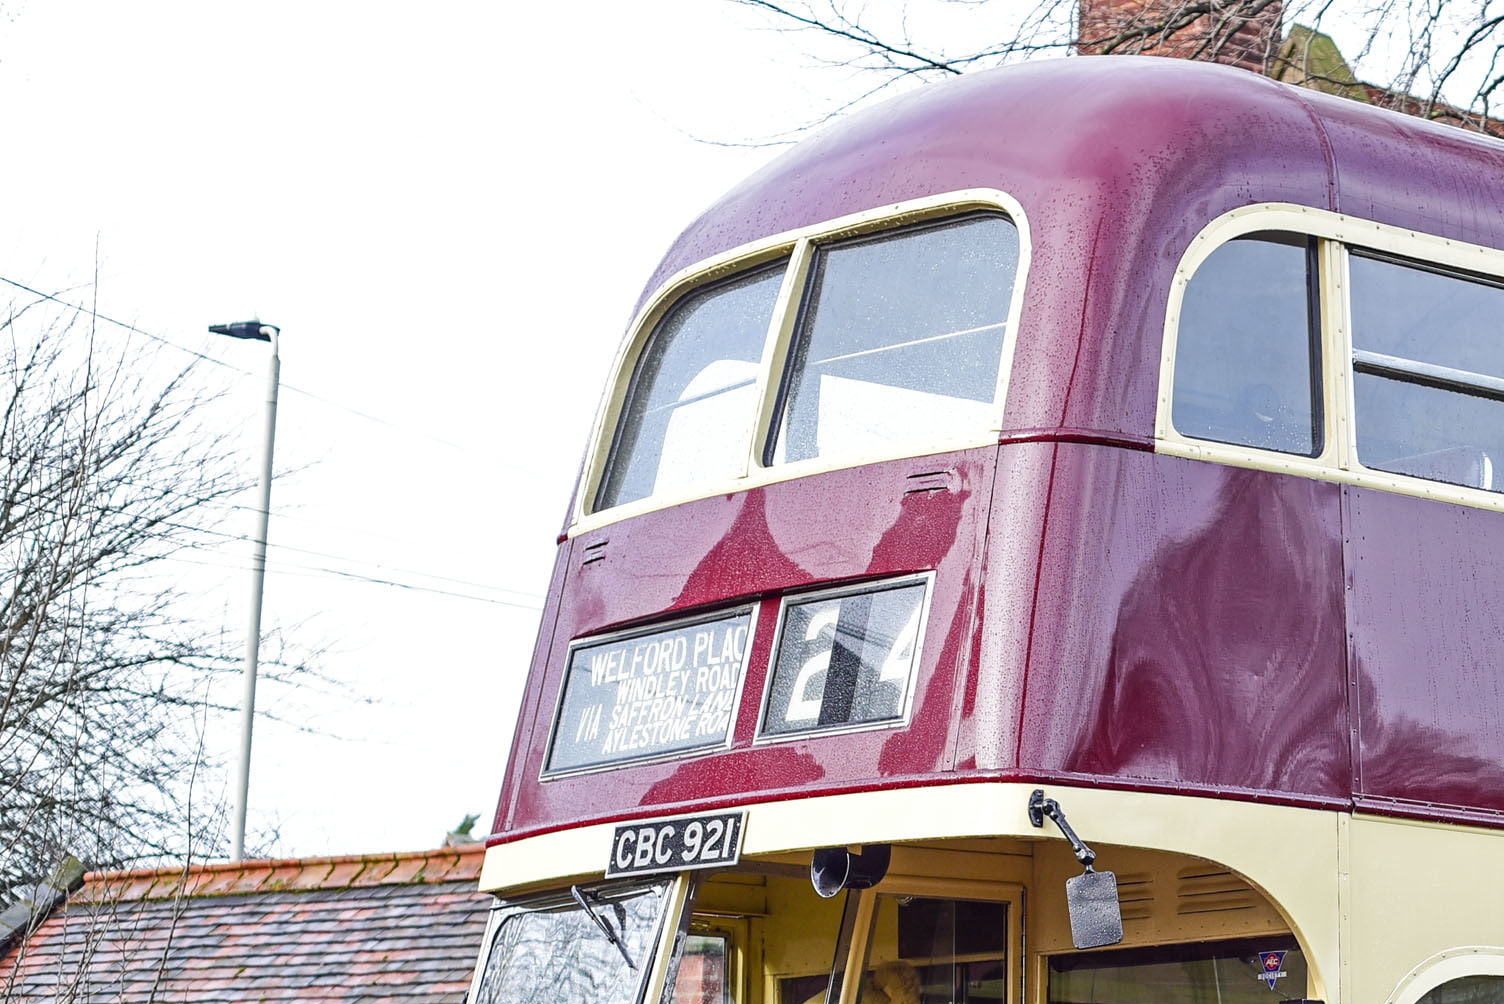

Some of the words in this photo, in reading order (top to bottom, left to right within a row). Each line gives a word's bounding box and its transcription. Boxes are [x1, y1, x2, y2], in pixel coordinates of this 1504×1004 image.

[592, 637, 686, 687] WELFORD
[617, 669, 691, 704] WINDLEY
[576, 703, 602, 743] VIA
[609, 696, 687, 730] SAFFRON
[602, 715, 697, 754] AYLESTONE
[616, 825, 676, 869] CBC
[682, 818, 735, 862] 921
